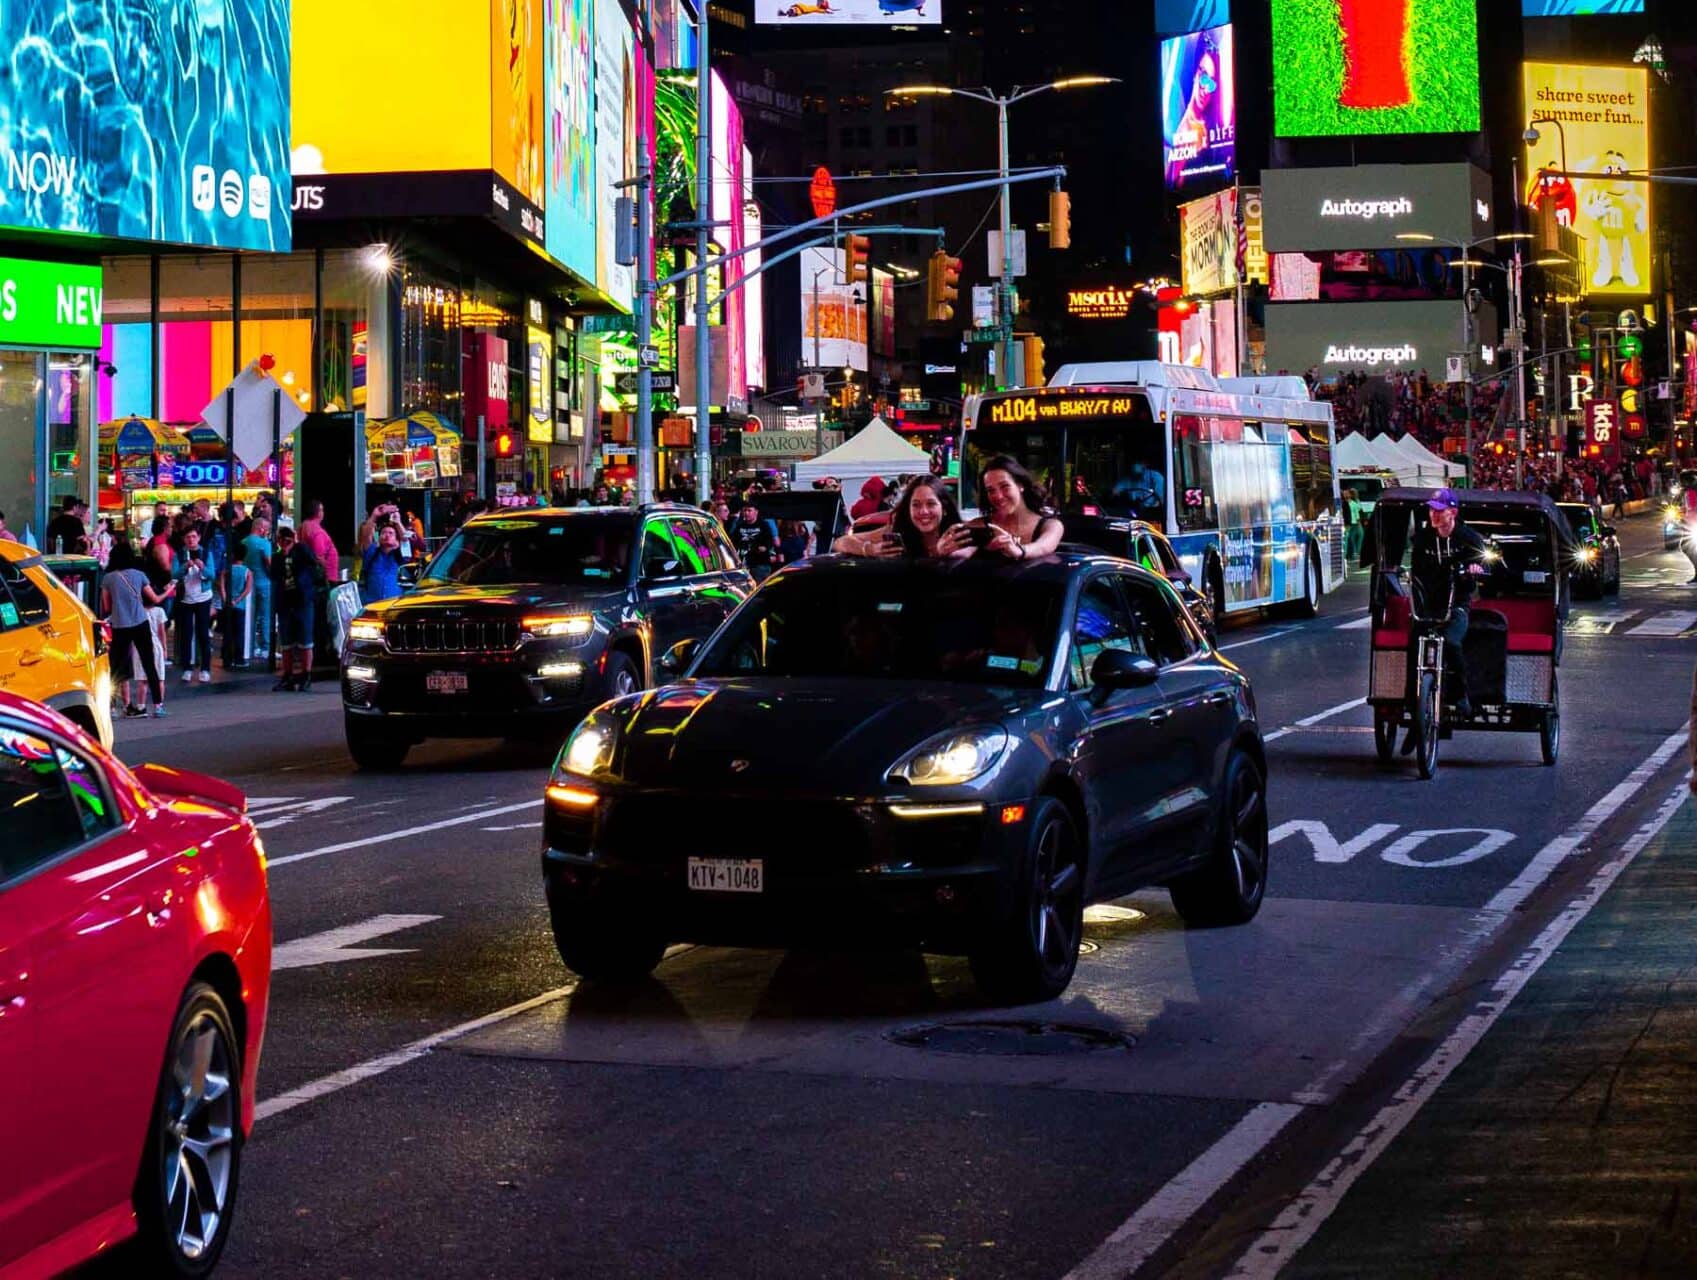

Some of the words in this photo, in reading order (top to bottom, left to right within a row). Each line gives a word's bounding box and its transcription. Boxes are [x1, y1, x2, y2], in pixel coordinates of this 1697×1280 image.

[1536, 87, 1583, 103] share
[1587, 92, 1635, 105] sweet
[1532, 105, 1601, 122] summer
[1210, 124, 1233, 142] DIFF
[8, 150, 75, 196] NOW
[1321, 197, 1413, 218] Autograph
[0, 280, 17, 322] S
[1324, 345, 1416, 364] Autograph
[992, 399, 1036, 422] M104
[1039, 406, 1058, 416] VIA
[1112, 399, 1131, 413] AV
